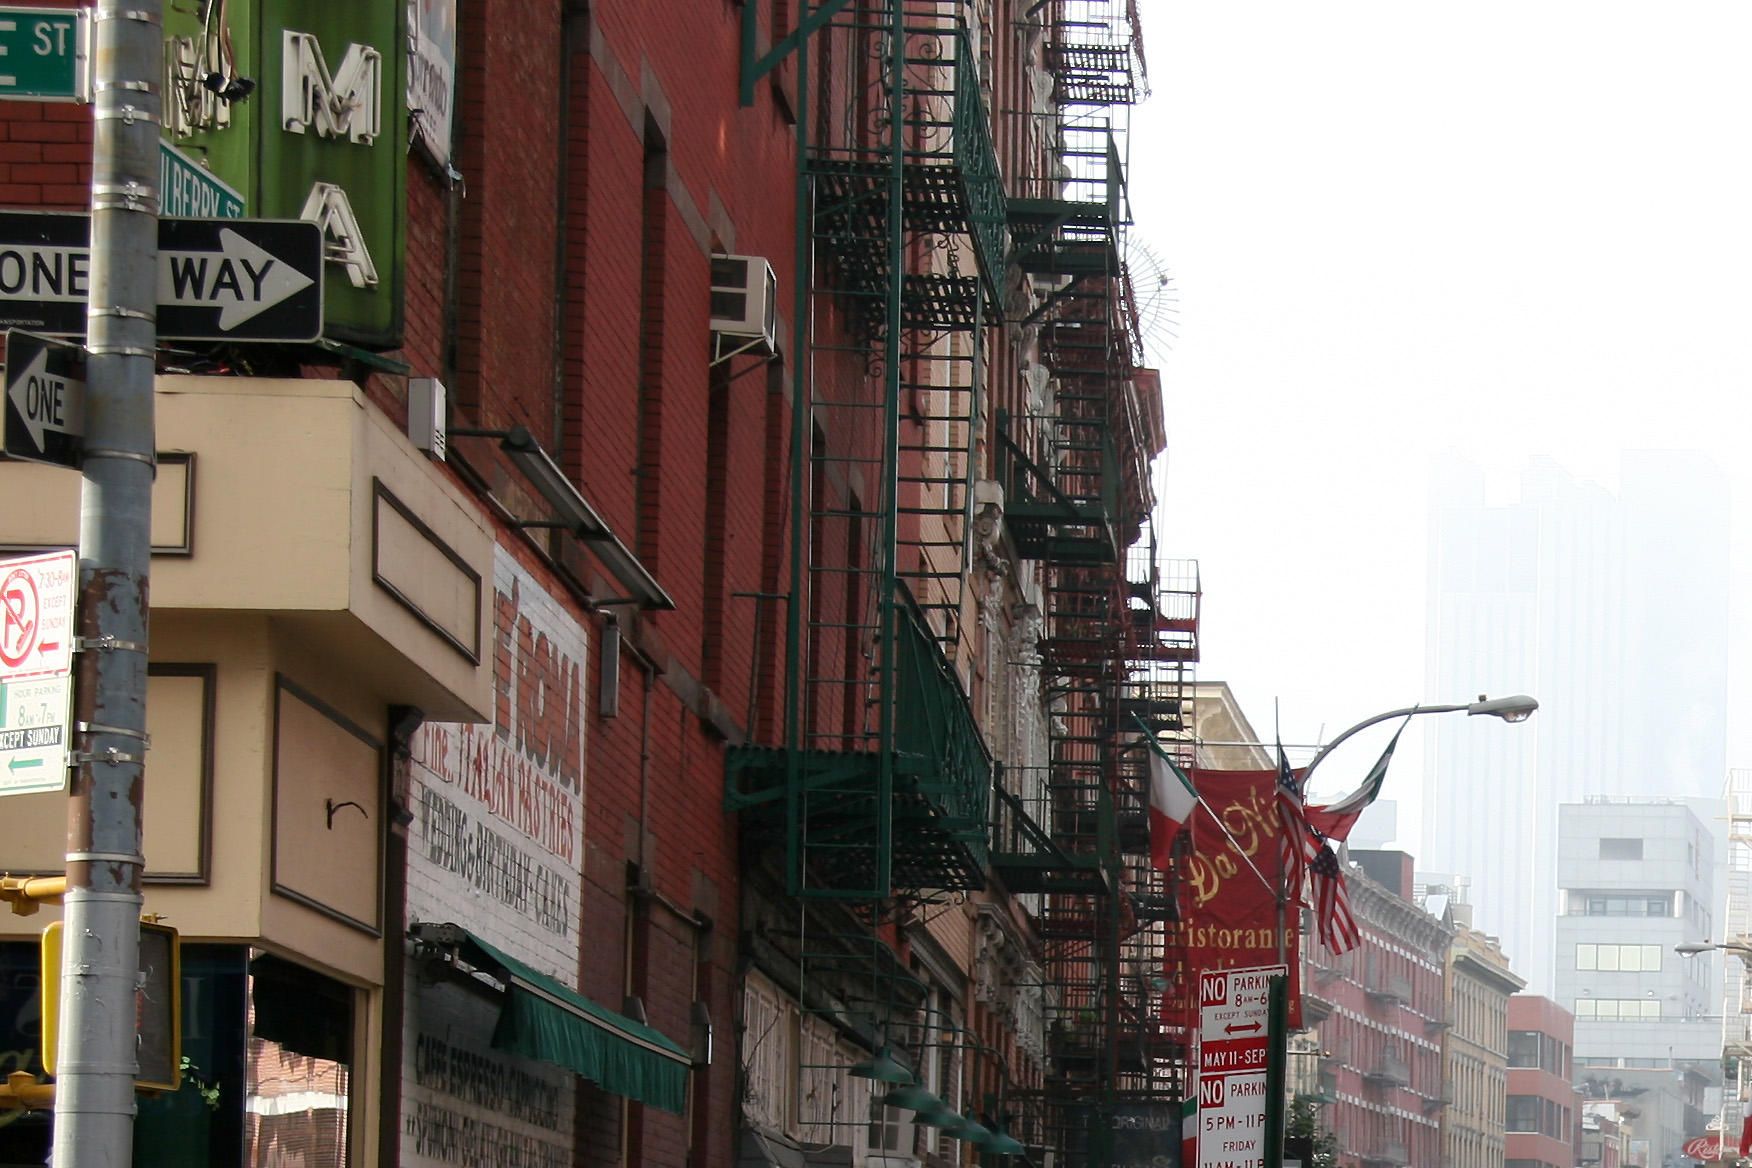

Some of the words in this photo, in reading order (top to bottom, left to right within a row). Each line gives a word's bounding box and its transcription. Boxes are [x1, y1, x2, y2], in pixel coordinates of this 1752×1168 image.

[33, 22, 70, 56] ST
[0, 249, 90, 297] ONE
[169, 255, 275, 302] WAY
[26, 374, 65, 427] ONE
[0, 730, 24, 750] XCEPT
[27, 726, 60, 747] SUNDAY
[1203, 977, 1226, 1003] NO
[1233, 974, 1271, 992] PARKIN
[1215, 1011, 1240, 1021] EXCEPT
[1204, 1052, 1227, 1068] MAY
[1200, 1080, 1224, 1106] NO
[1231, 1082, 1267, 1097] PARKIN
[1206, 1119, 1214, 1131] 5
[1216, 1117, 1235, 1130] PM
[1256, 1113, 1265, 1127] P
[1222, 1139, 1256, 1152] FRIDAY
